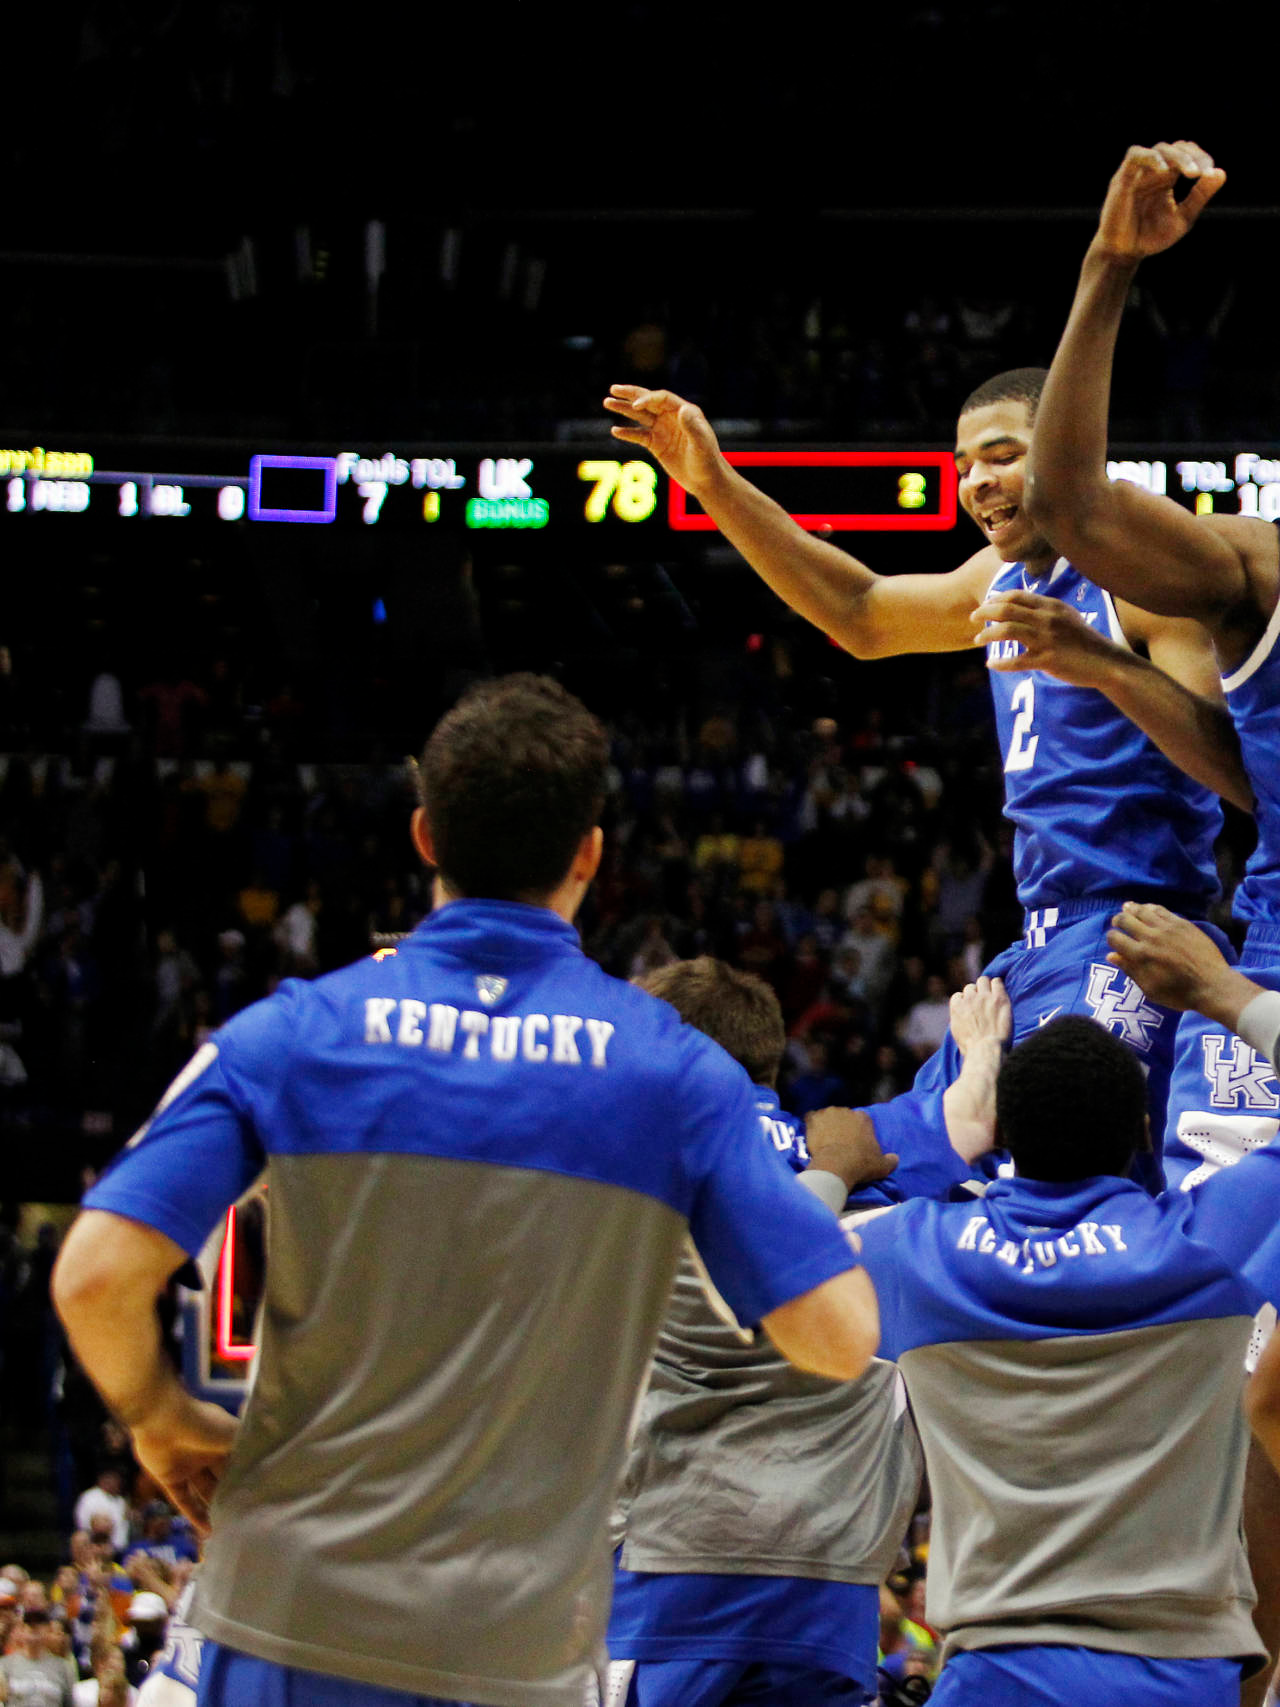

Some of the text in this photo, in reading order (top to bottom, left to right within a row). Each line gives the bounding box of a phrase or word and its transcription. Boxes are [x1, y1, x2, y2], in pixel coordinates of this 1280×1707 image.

[337, 452, 409, 485] Fouls
[412, 458, 465, 489] TOL
[480, 459, 533, 499] UK
[1178, 462, 1234, 491] TOL
[358, 482, 388, 524] 7
[577, 459, 658, 523] 78
[467, 498, 549, 528] BONUS
[1003, 676, 1040, 773] 2
[364, 997, 615, 1068] KENTUCKY
[1202, 1034, 1280, 1110] UK
